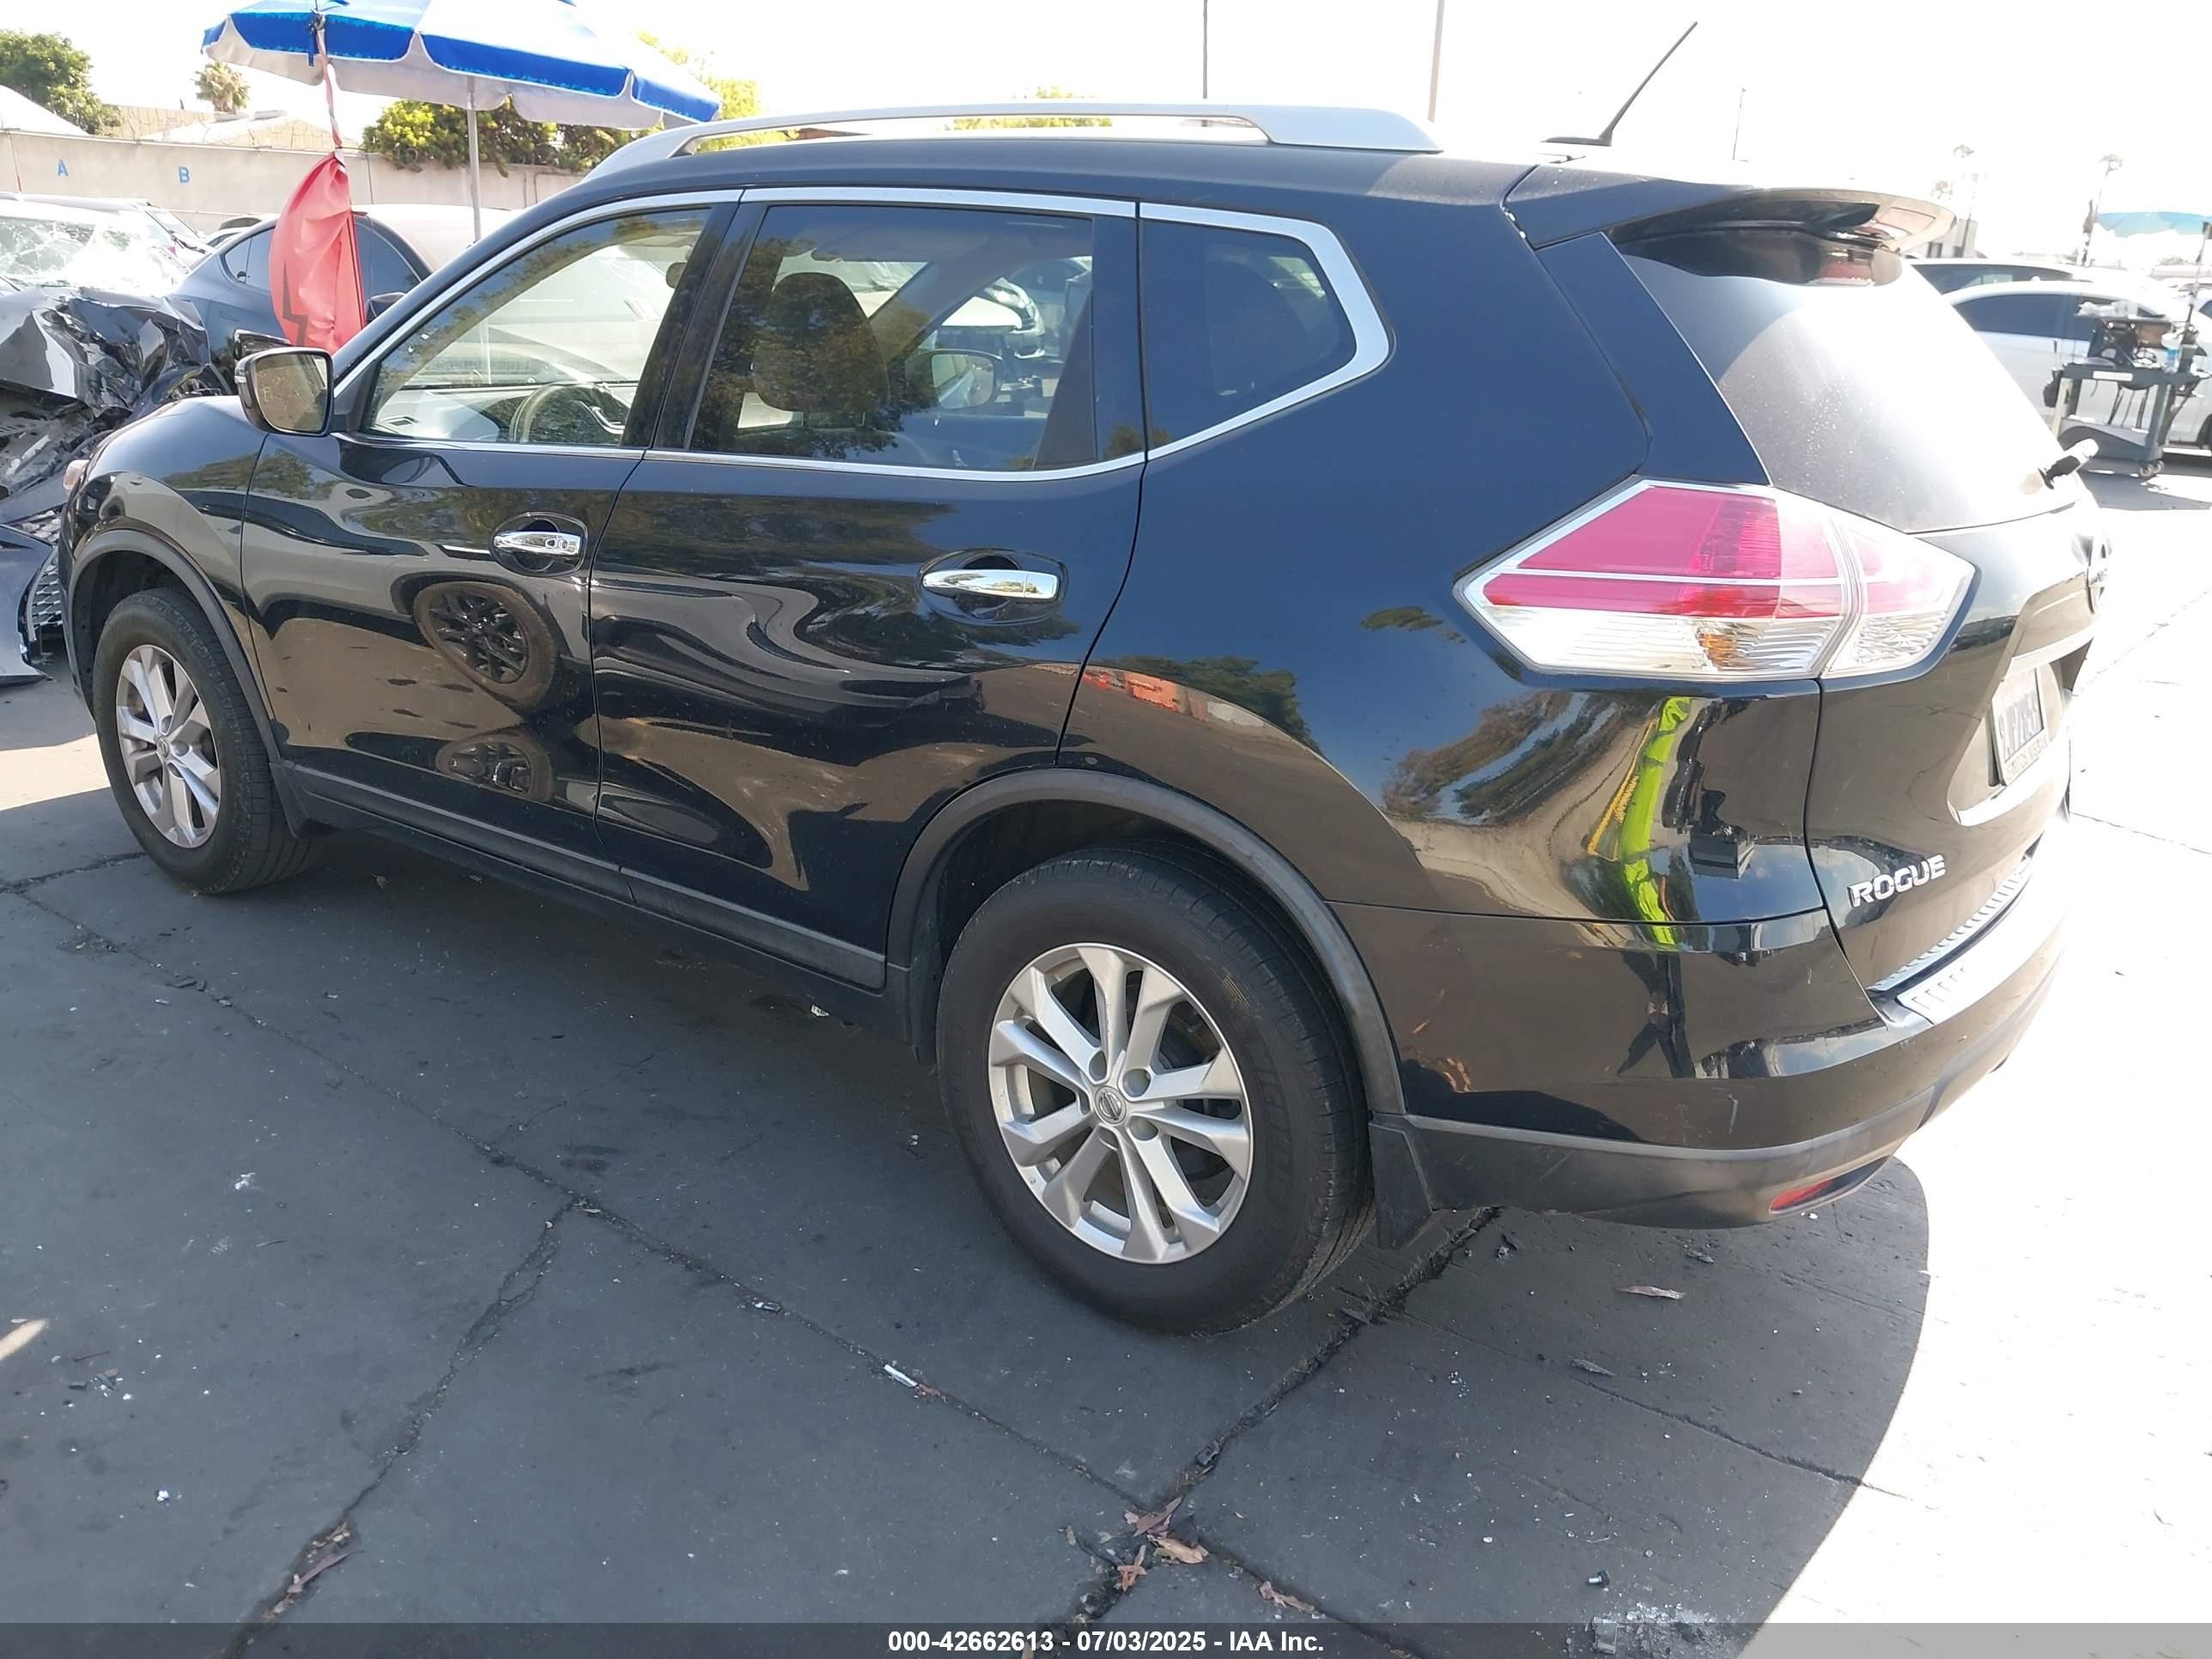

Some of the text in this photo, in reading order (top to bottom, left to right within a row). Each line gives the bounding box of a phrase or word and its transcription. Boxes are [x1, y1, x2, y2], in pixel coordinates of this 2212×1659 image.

[57, 158, 70, 177] A
[178, 166, 191, 184] B
[1846, 854, 1946, 908] ROGUE
